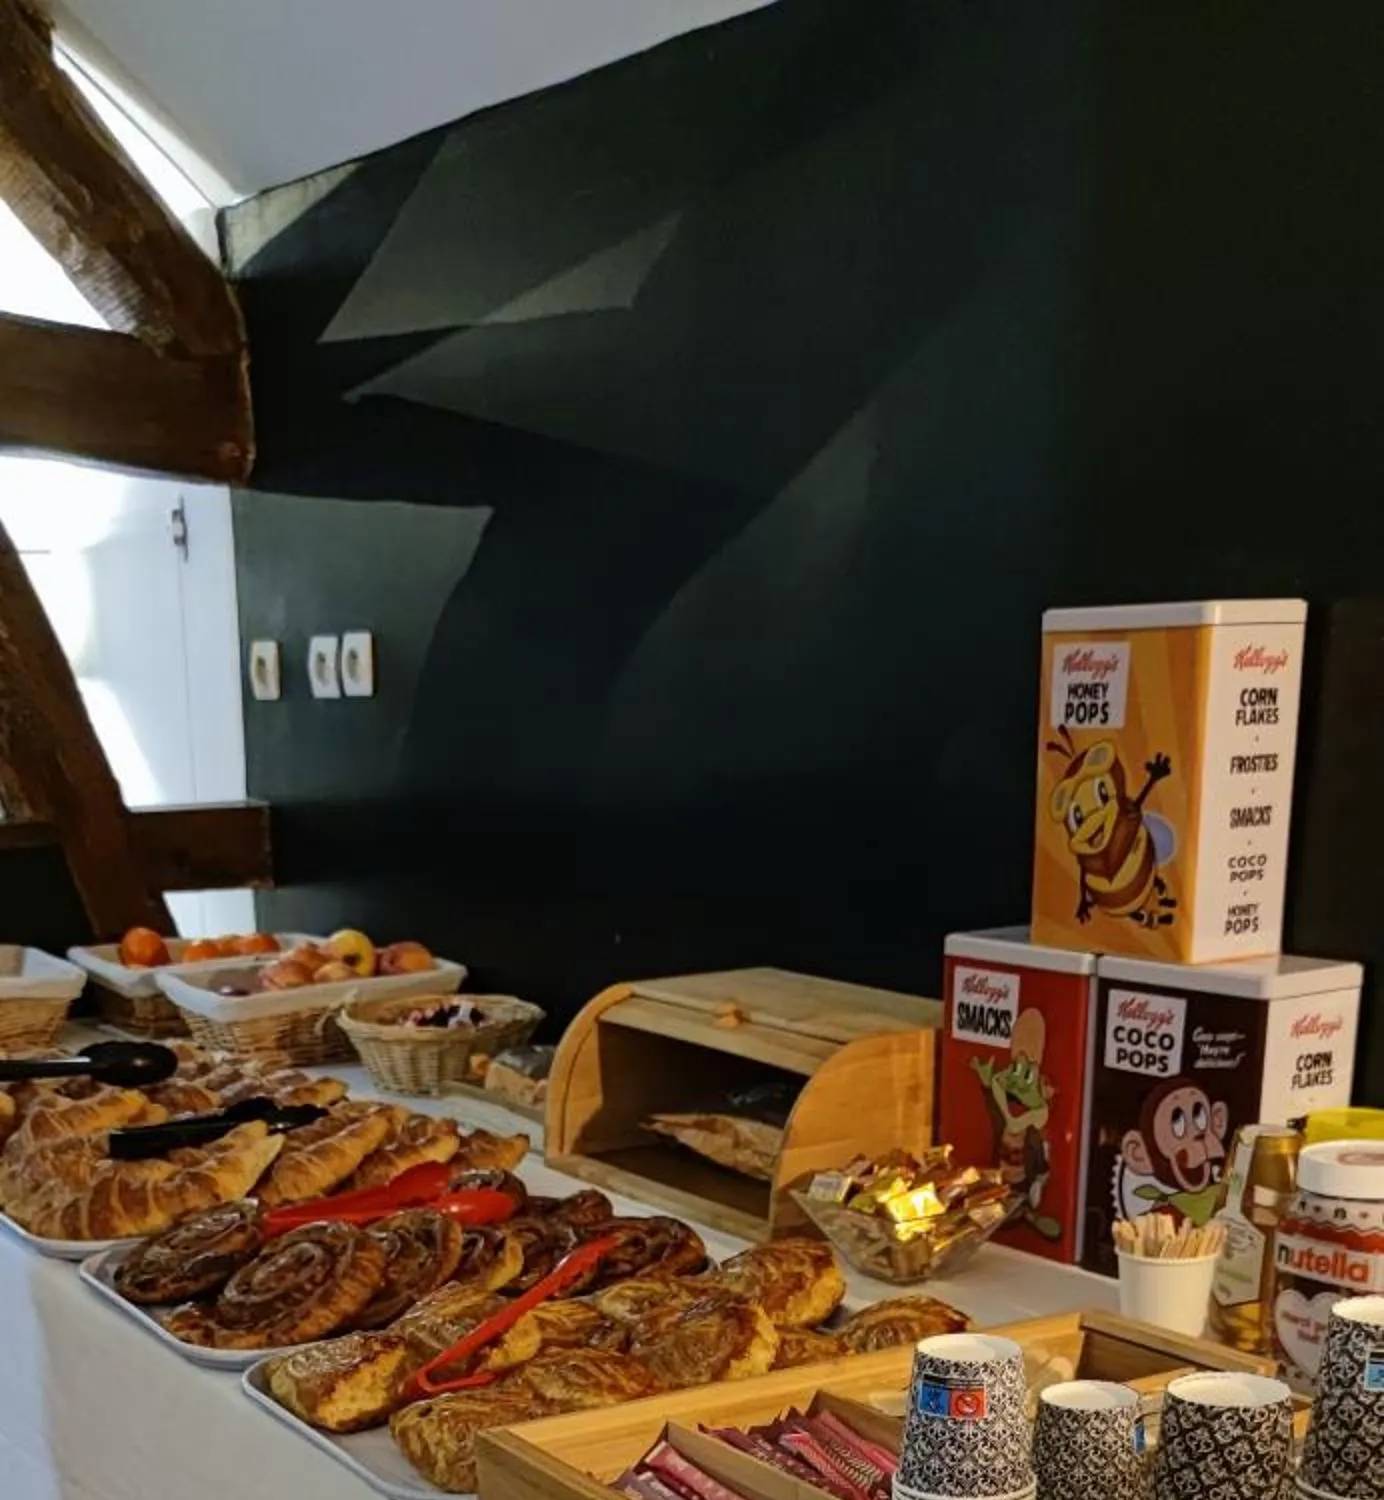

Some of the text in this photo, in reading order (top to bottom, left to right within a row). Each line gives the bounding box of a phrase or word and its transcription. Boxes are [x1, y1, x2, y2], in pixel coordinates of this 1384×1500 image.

[1062, 648, 1119, 680] Kellogg's
[1232, 643, 1288, 675] Kellogg's
[1067, 681, 1109, 700] HONEY
[1240, 687, 1278, 706] CORN
[1064, 701, 1109, 724] POPS
[1235, 707, 1279, 726] FLAKES
[1229, 752, 1279, 774] FROSTIES
[1229, 804, 1272, 828] SMACKS
[1227, 853, 1267, 869] COCO
[1229, 868, 1264, 882] POPS
[1224, 916, 1259, 936] POPS
[961, 973, 1010, 1005] Kellogg's
[957, 1001, 1012, 1039] SMACKS
[1116, 995, 1175, 1030] Kellogg's
[1113, 1025, 1175, 1051] COCO
[1116, 1048, 1168, 1073] POPS
[1296, 1050, 1333, 1071] CORN
[1291, 1068, 1333, 1090] FLAKES
[1278, 1243, 1369, 1284] nutella
